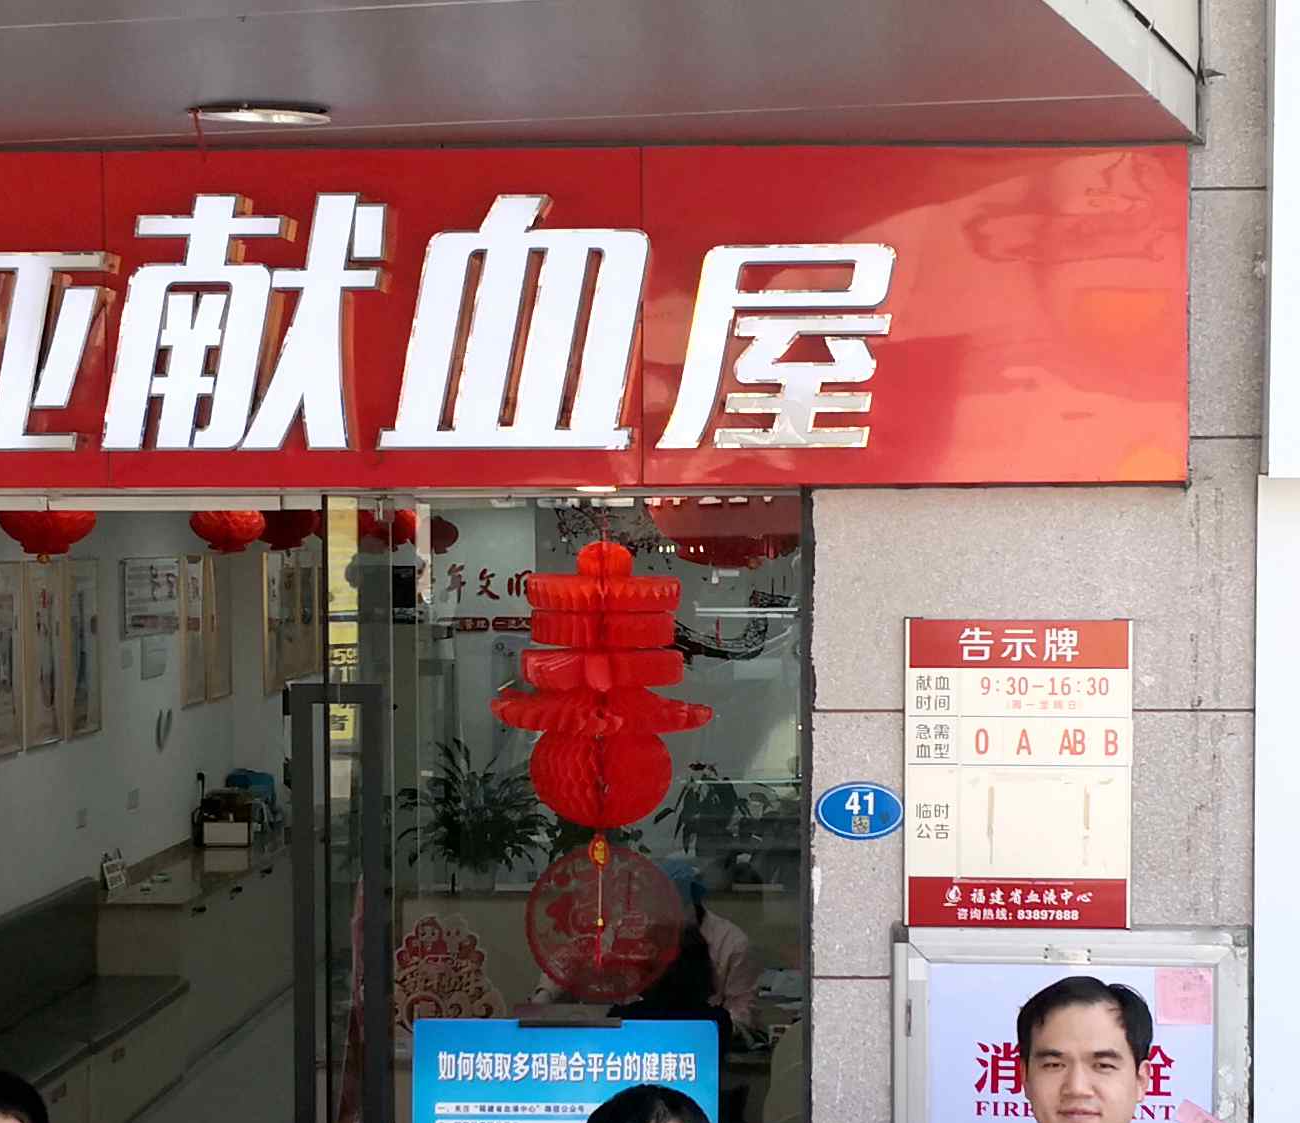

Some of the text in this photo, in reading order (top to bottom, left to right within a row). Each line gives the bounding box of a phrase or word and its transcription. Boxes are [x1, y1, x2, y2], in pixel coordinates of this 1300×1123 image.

[958, 626, 1080, 662] 告示牌
[915, 675, 950, 691] 献血
[915, 694, 950, 711] 时间
[915, 723, 950, 740] 急需
[915, 743, 950, 759] 血型
[1016, 729, 1032, 756] A
[1058, 729, 1086, 756] AB
[1104, 729, 1119, 756] B
[844, 791, 875, 816] 41
[915, 803, 950, 820] 临时
[915, 823, 950, 840] 公告
[969, 887, 1094, 906] 福建省血液中心
[437, 1050, 698, 1083] 如何领取多码融合平台的健康码
